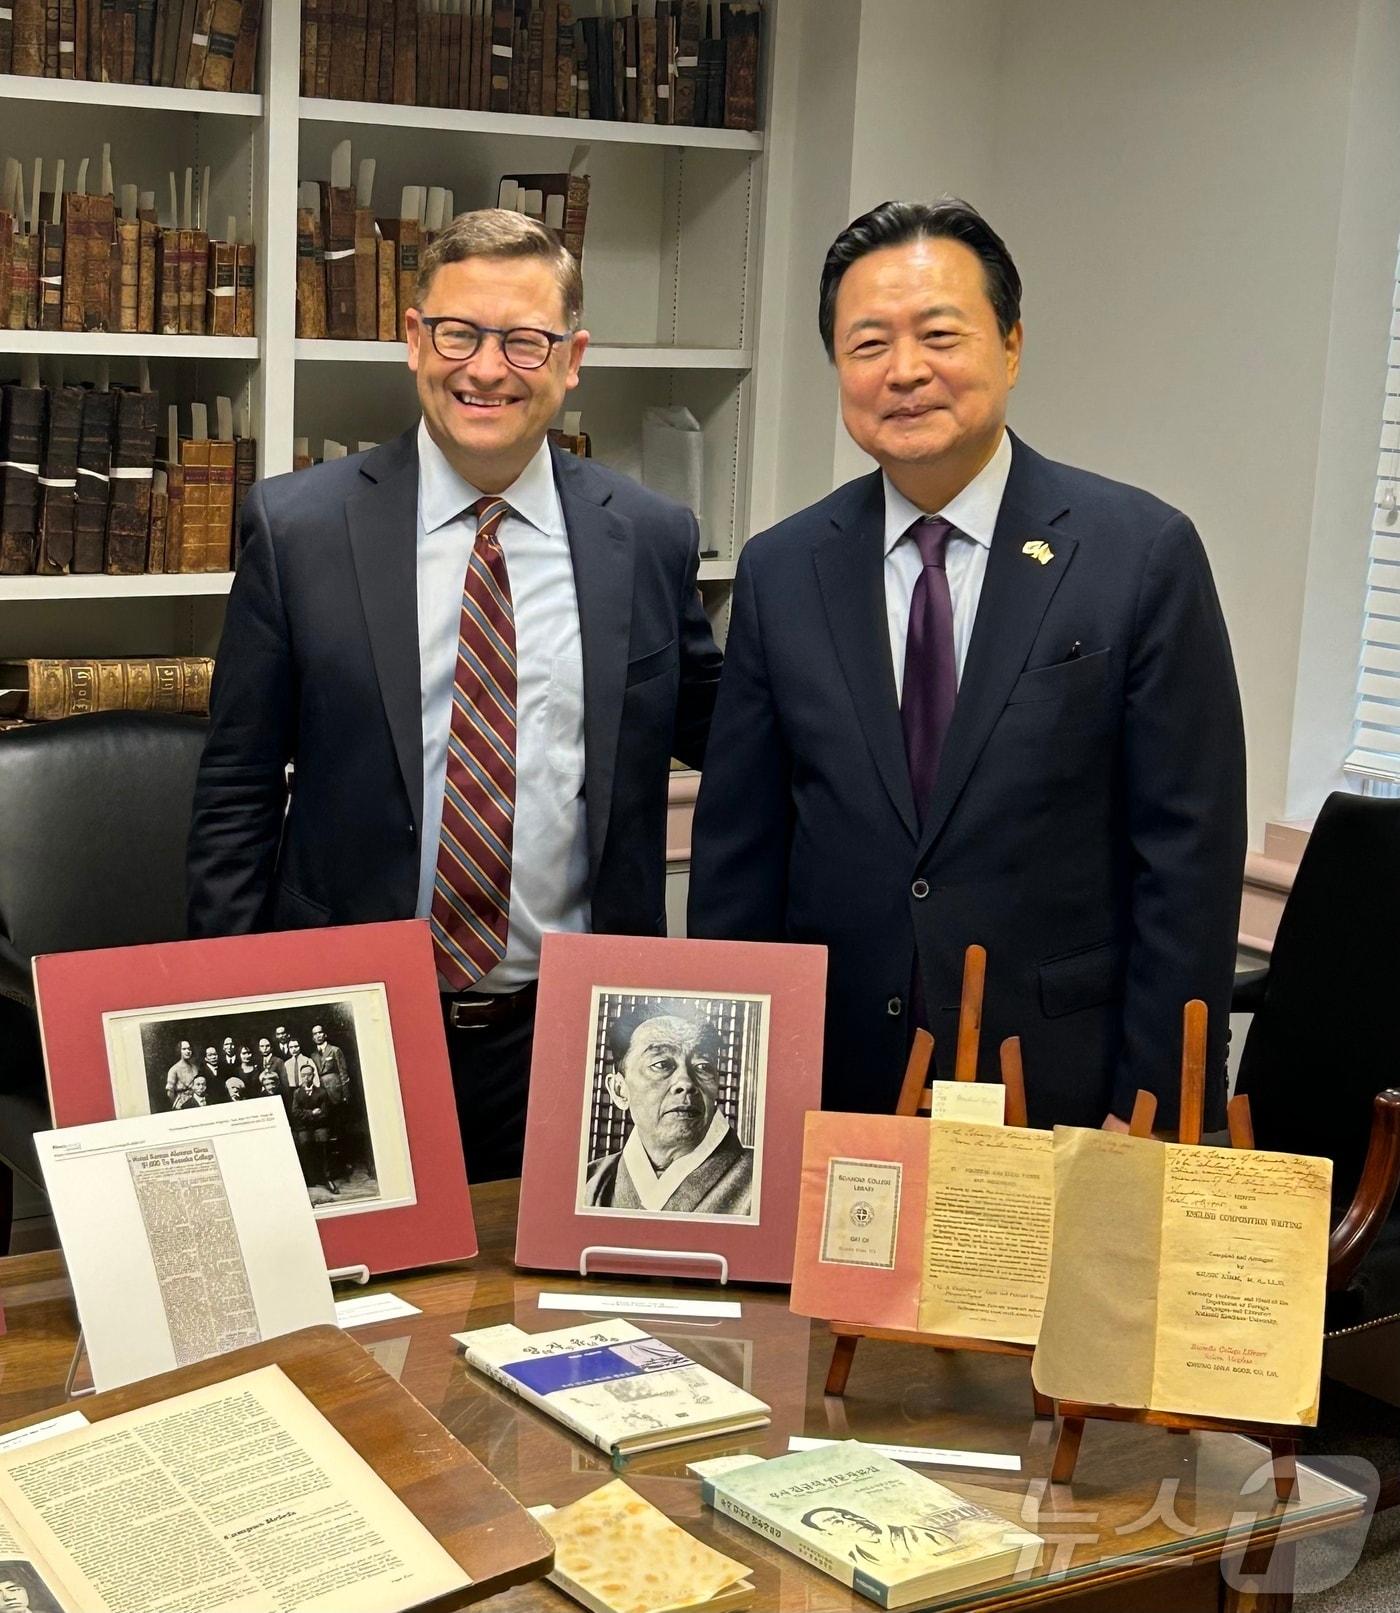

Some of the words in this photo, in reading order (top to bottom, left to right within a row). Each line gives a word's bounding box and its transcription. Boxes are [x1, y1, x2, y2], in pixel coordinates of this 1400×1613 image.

[867, 1176, 892, 1186] COLLEGE
[1185, 1209, 1217, 1221] ENGLISH
[1219, 1214, 1268, 1227] COMPOSITION
[1270, 1218, 1303, 1230] WRITING
[1242, 1348, 1268, 1358] Library
